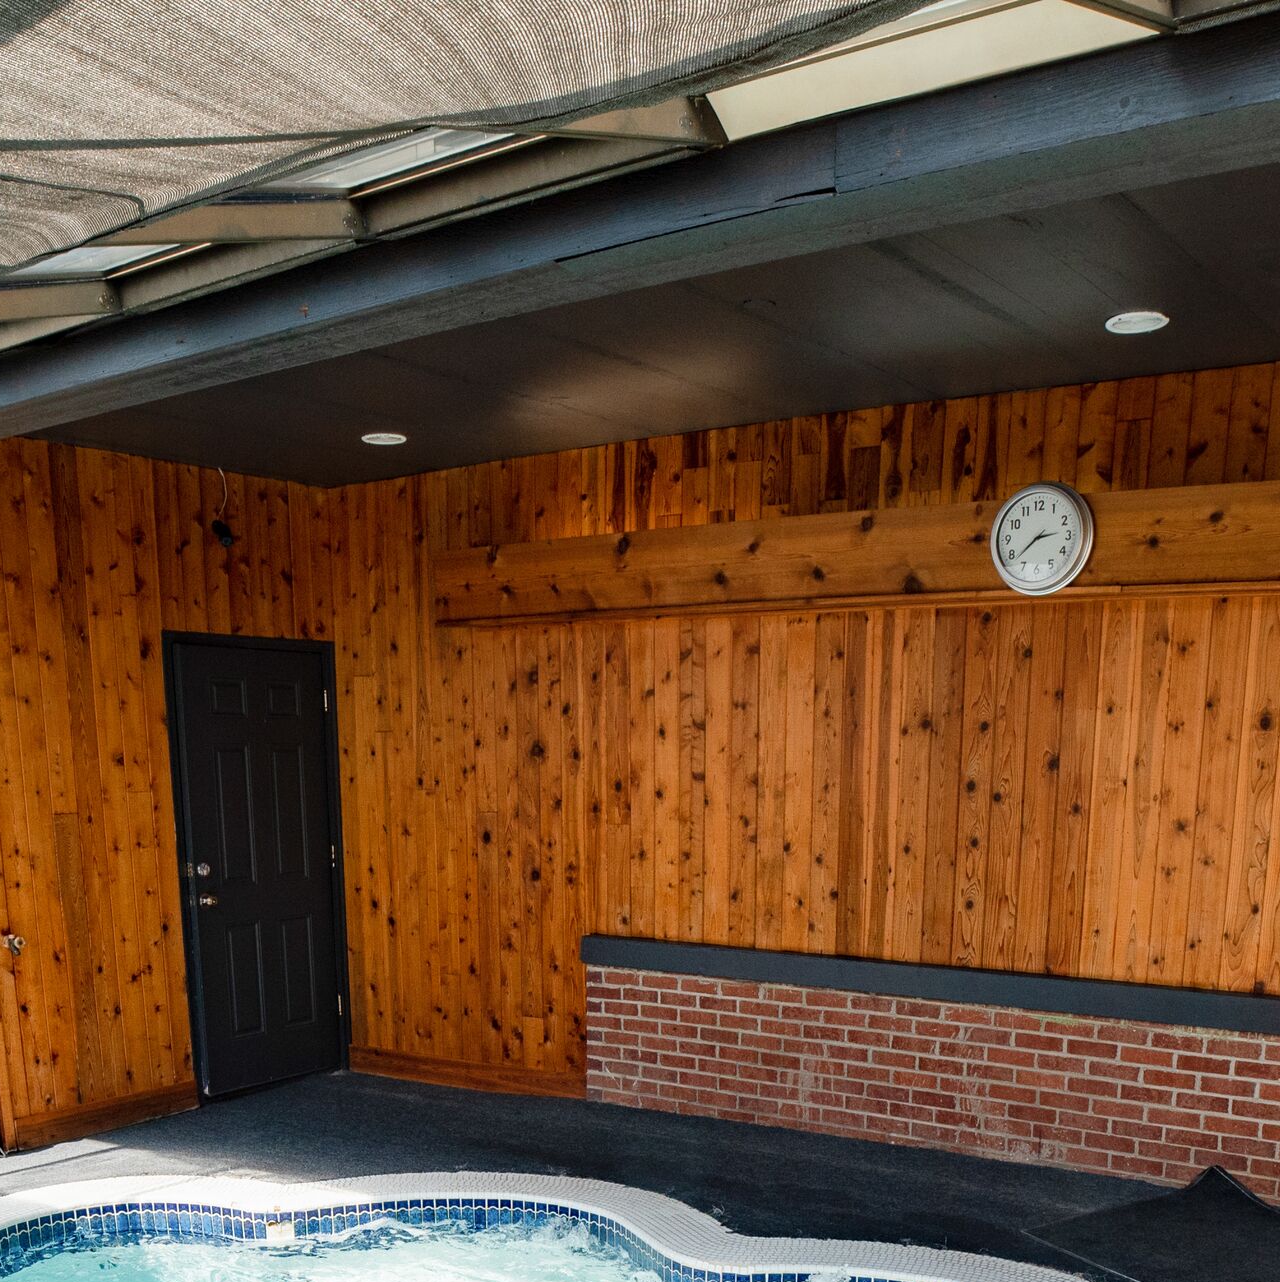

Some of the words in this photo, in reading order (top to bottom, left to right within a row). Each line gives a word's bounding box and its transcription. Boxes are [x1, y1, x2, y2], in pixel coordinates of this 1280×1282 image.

[1034, 500, 1045, 511] 12
[1052, 504, 1056, 514] 1
[1022, 506, 1030, 516] 11
[1010, 519, 1021, 529] 10
[1061, 515, 1068, 526] 2
[1005, 535, 1012, 545] 9
[1065, 530, 1072, 540] 3
[1008, 549, 1015, 560] 8
[1059, 546, 1066, 556] 4
[1020, 562, 1027, 572] 7
[1033, 564, 1040, 574] 6
[1048, 559, 1054, 570] 5
